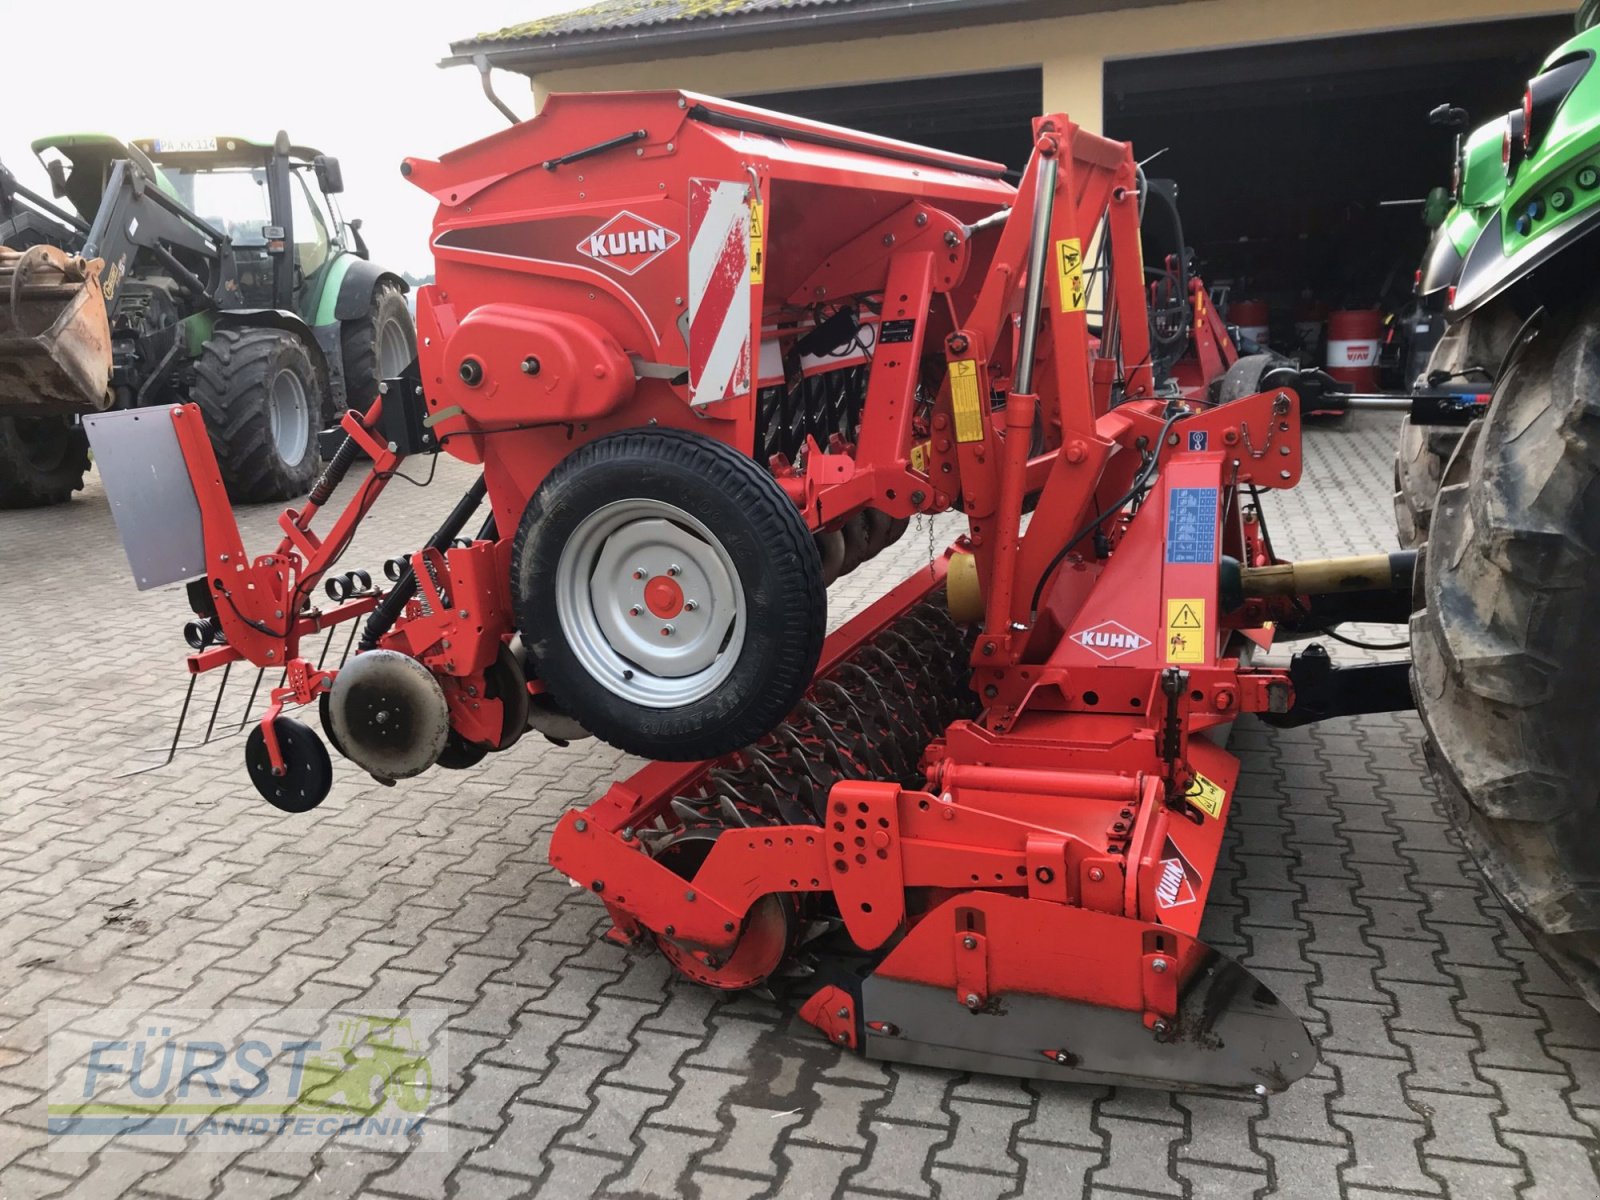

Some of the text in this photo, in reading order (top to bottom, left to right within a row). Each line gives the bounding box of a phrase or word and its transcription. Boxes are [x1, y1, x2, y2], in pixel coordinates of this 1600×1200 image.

[590, 228, 667, 257] KUHN
[1081, 631, 1140, 649] KUHN
[1156, 860, 1184, 905] KUHN
